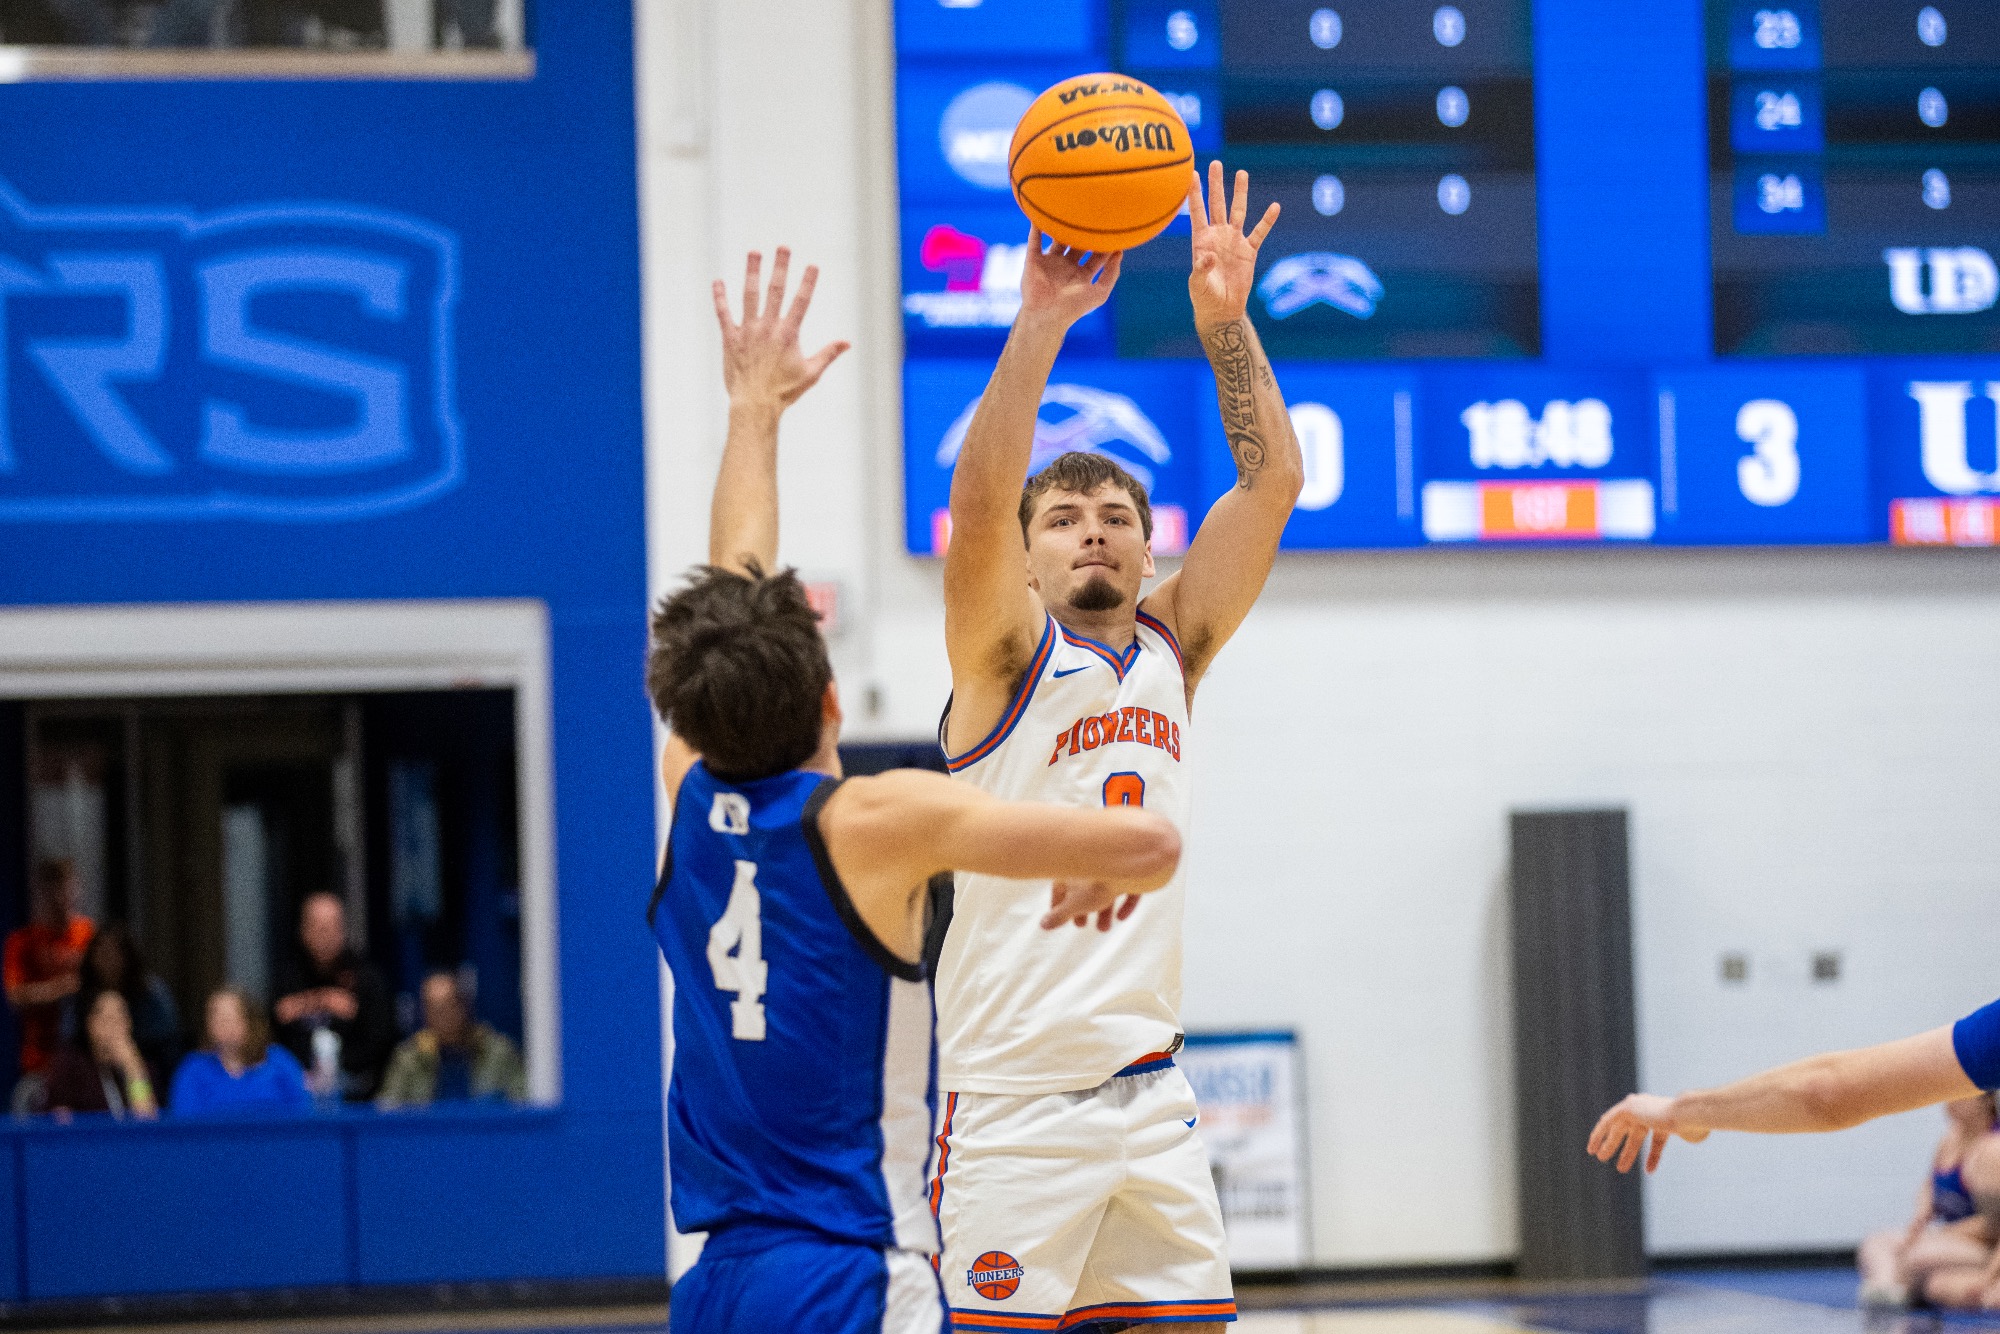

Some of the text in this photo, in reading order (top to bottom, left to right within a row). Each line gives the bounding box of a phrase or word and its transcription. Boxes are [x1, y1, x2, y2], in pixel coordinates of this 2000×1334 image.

[1054, 121, 1176, 153] Wilson
[1735, 398, 1801, 507] 3
[1048, 706, 1181, 767] PIONEERS
[706, 859, 768, 1041] 4
[966, 1265, 1025, 1287] PIONEERS
